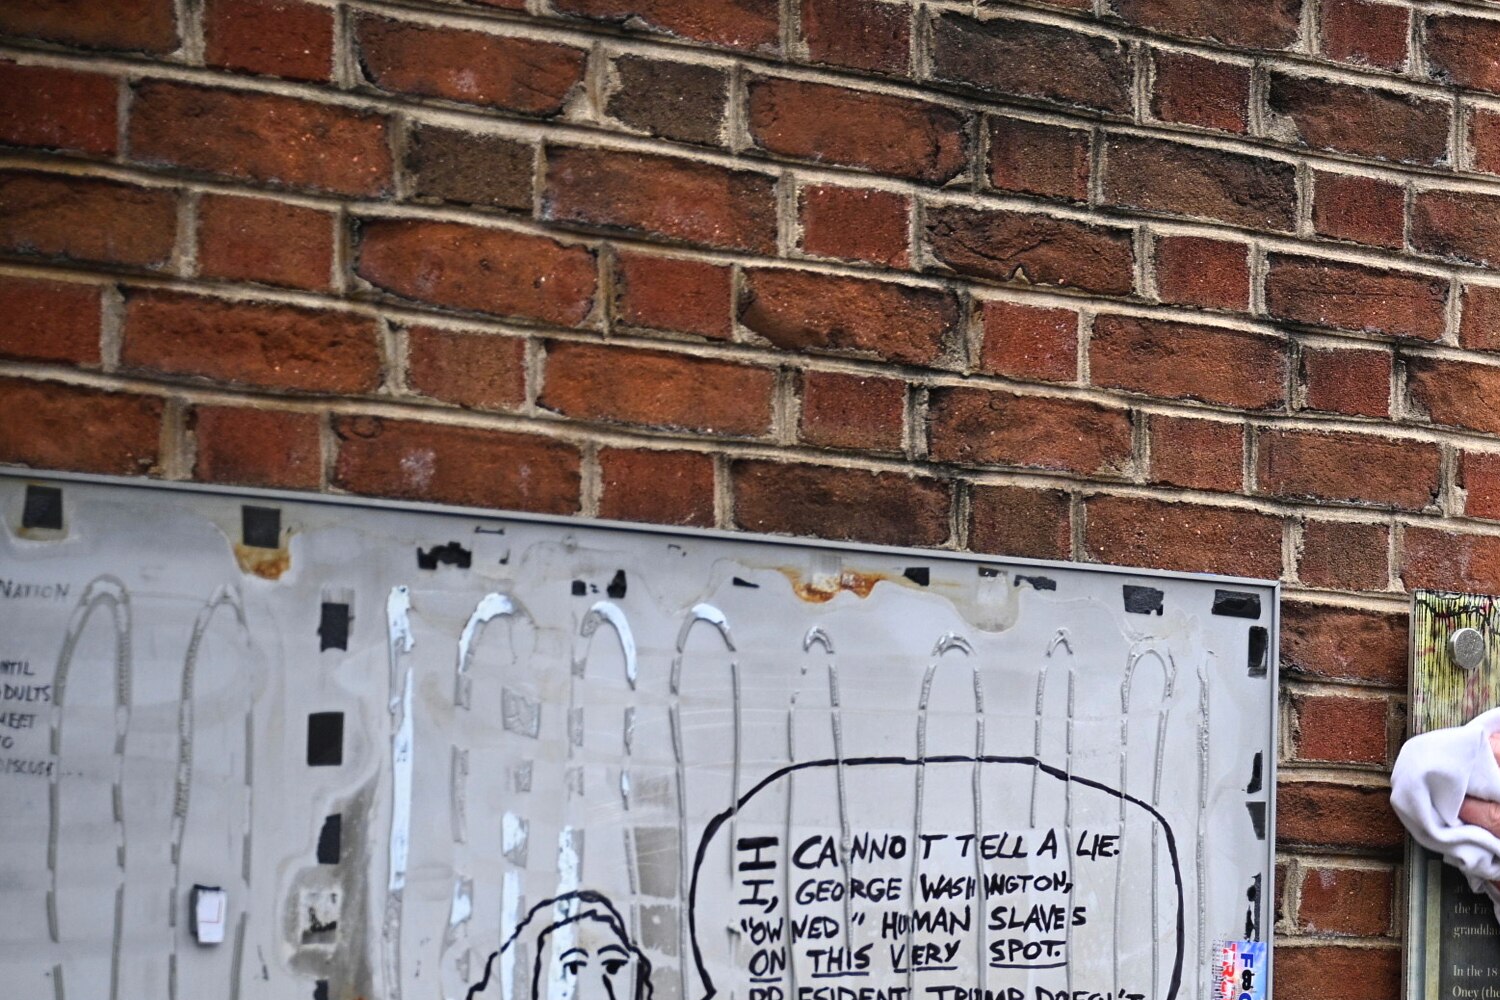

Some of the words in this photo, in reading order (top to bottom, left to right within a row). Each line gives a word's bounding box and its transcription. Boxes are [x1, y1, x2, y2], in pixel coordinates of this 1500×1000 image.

[0, 684, 51, 702] DULTS
[737, 836, 779, 871] I
[956, 832, 1028, 860] TELL
[1036, 828, 1058, 859] A
[1076, 830, 1120, 861] LIE.
[738, 880, 779, 913] I,
[795, 878, 902, 905] GEORGE
[920, 870, 1073, 902] WASHINGTON,
[882, 905, 971, 940] HUMAN
[988, 904, 1086, 933] SLAVES
[749, 946, 786, 977] ON
[806, 943, 873, 973] THIS
[891, 940, 961, 970] VERY
[989, 938, 1066, 962] SPOT.
[1453, 964, 1464, 977] In
[1466, 964, 1483, 977] the
